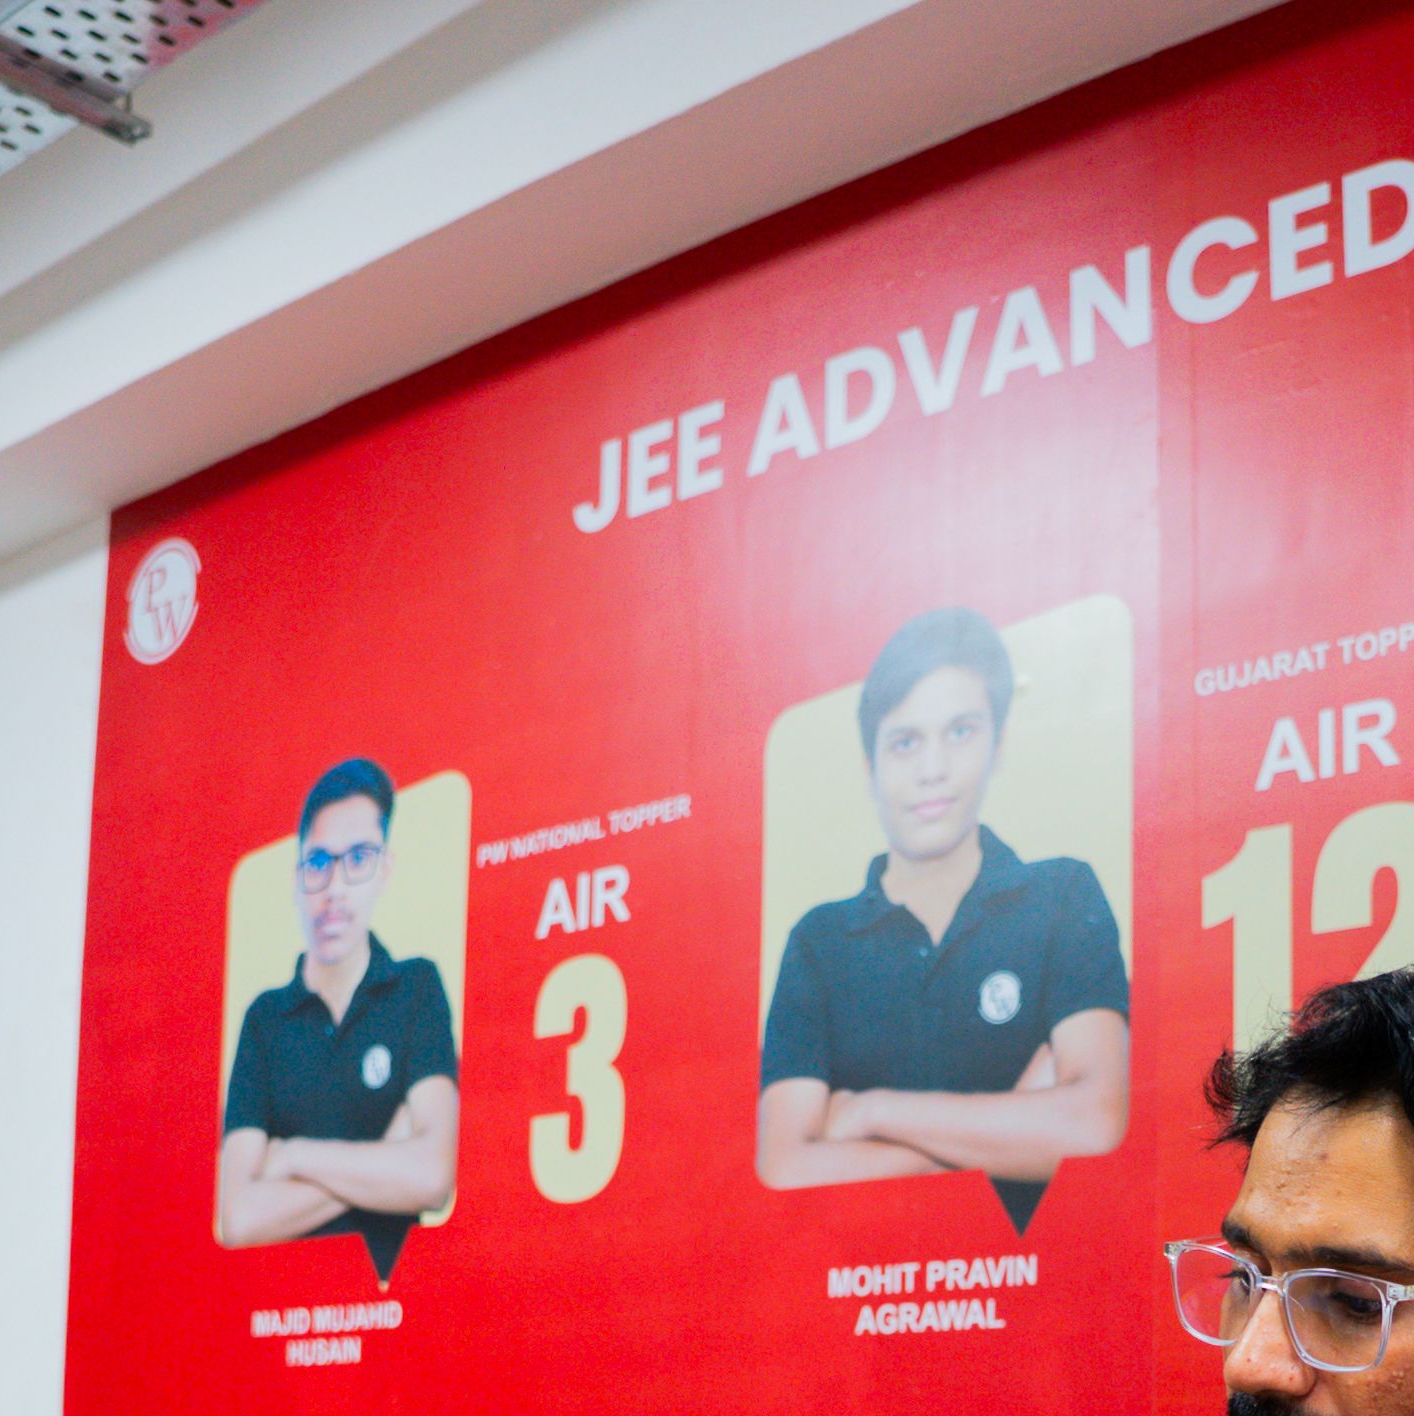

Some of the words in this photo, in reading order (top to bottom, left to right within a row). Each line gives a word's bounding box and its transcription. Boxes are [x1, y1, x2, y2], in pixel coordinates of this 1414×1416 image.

[573, 400, 726, 535] JEE
[1193, 641, 1331, 697] GUJARAT
[1254, 697, 1400, 792] AIR
[476, 842, 509, 868] PW
[510, 817, 607, 861] NATIONAL
[608, 794, 692, 836] TOPPER
[535, 864, 632, 941] AIR
[529, 953, 628, 1204] 3
[827, 1261, 921, 1298] MOHIT
[925, 1254, 1038, 1292] PRAVIN
[250, 1306, 311, 1338] MAJID
[311, 1299, 404, 1334] MUJAHID
[854, 1298, 1007, 1336] AGRAWAL
[285, 1335, 363, 1368] HUSAIN
